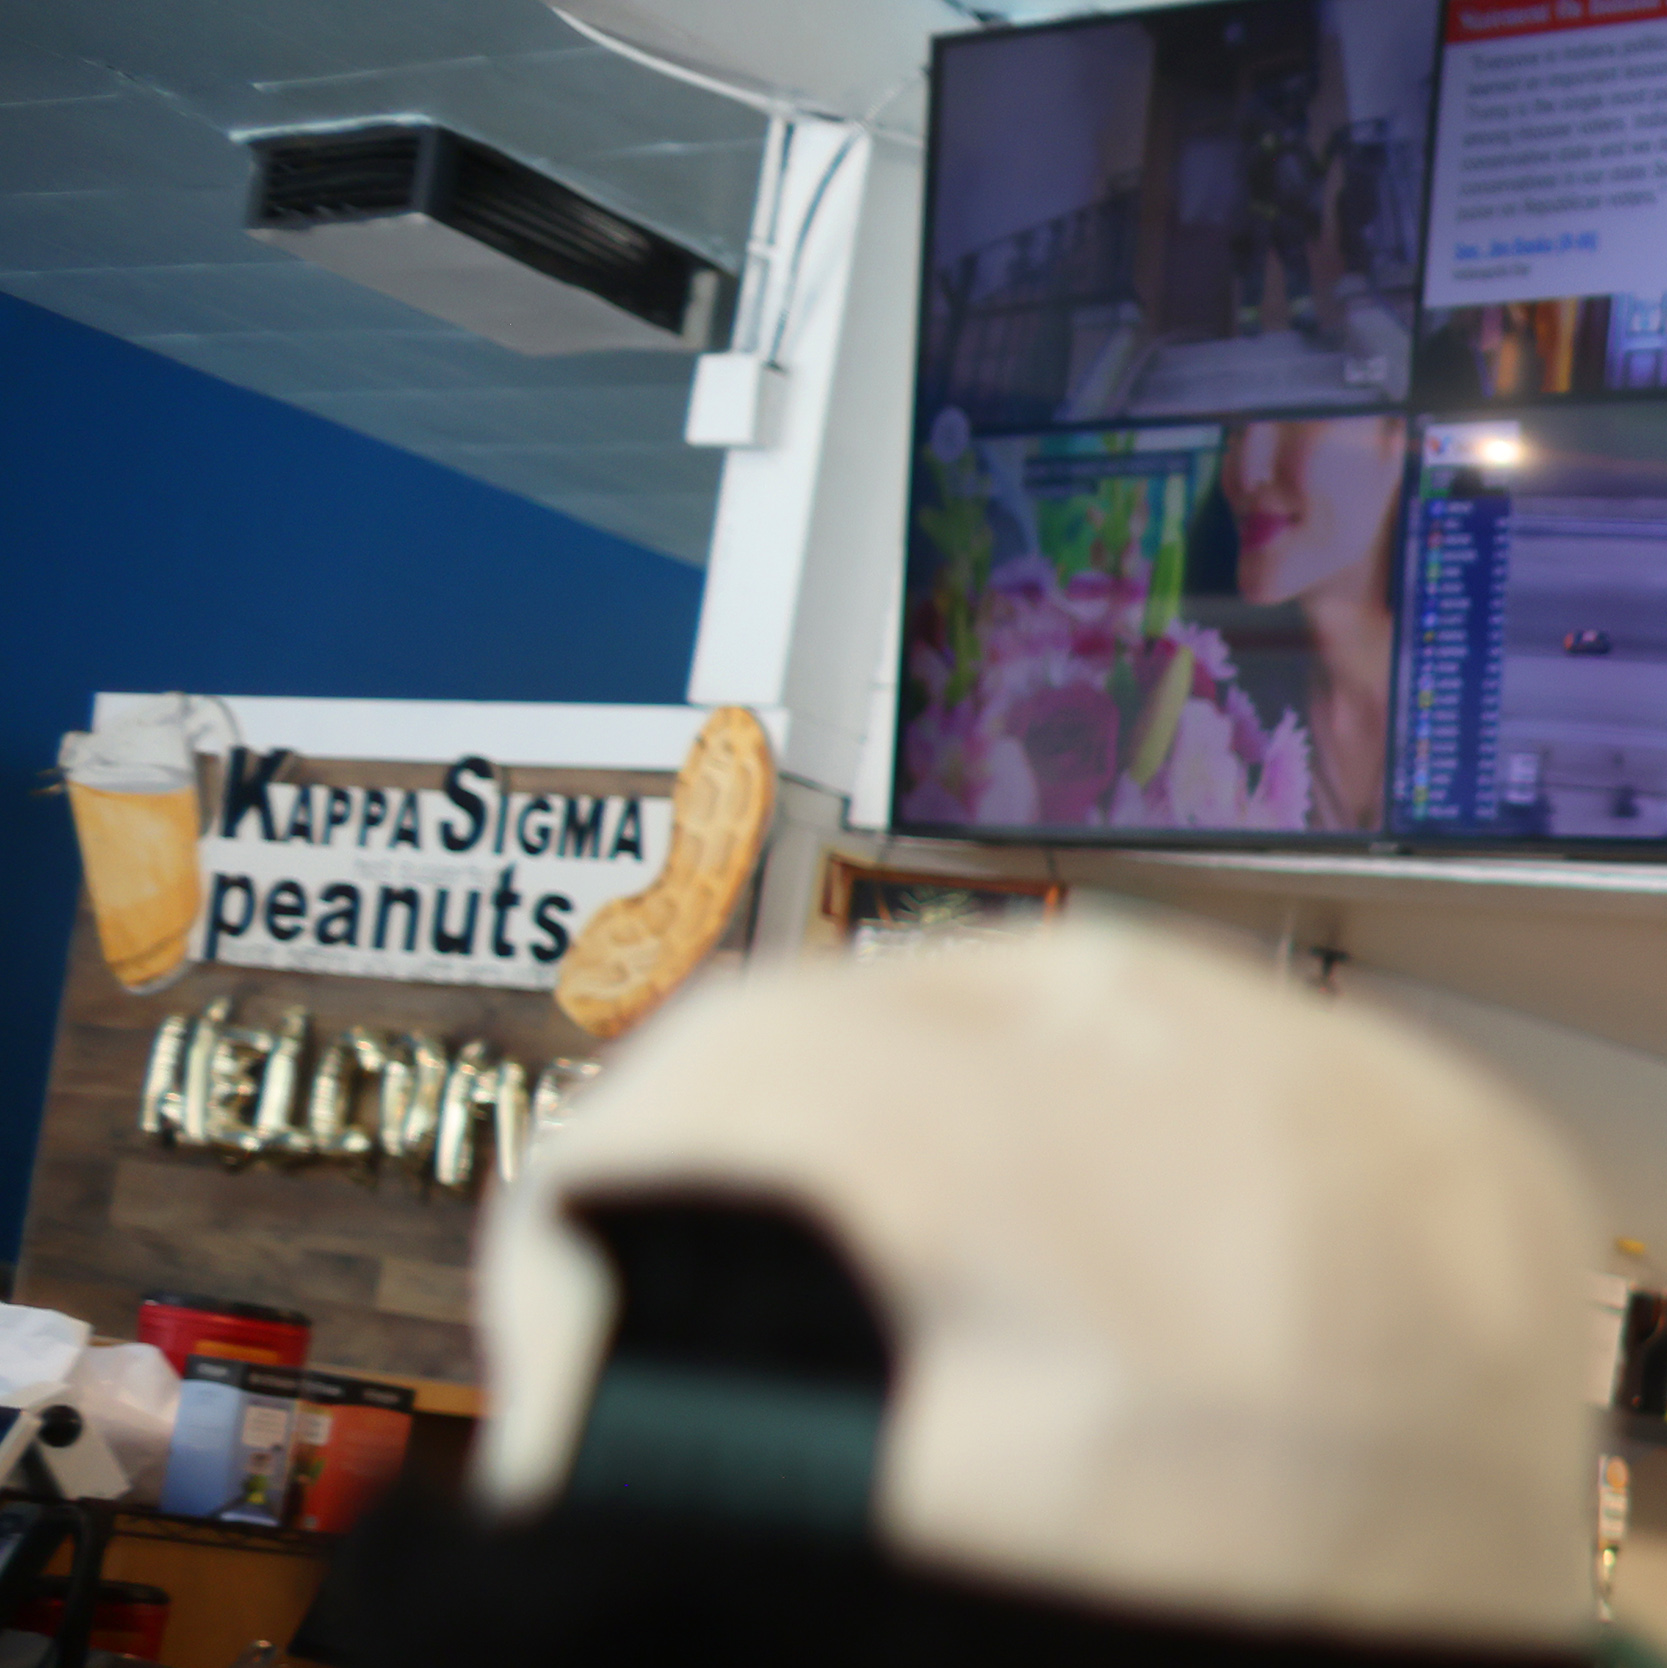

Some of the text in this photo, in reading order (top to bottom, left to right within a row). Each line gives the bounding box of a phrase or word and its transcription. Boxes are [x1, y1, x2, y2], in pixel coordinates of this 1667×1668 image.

[220, 746, 646, 862] KAPPA SIGMA
[202, 863, 574, 963] peanuts
